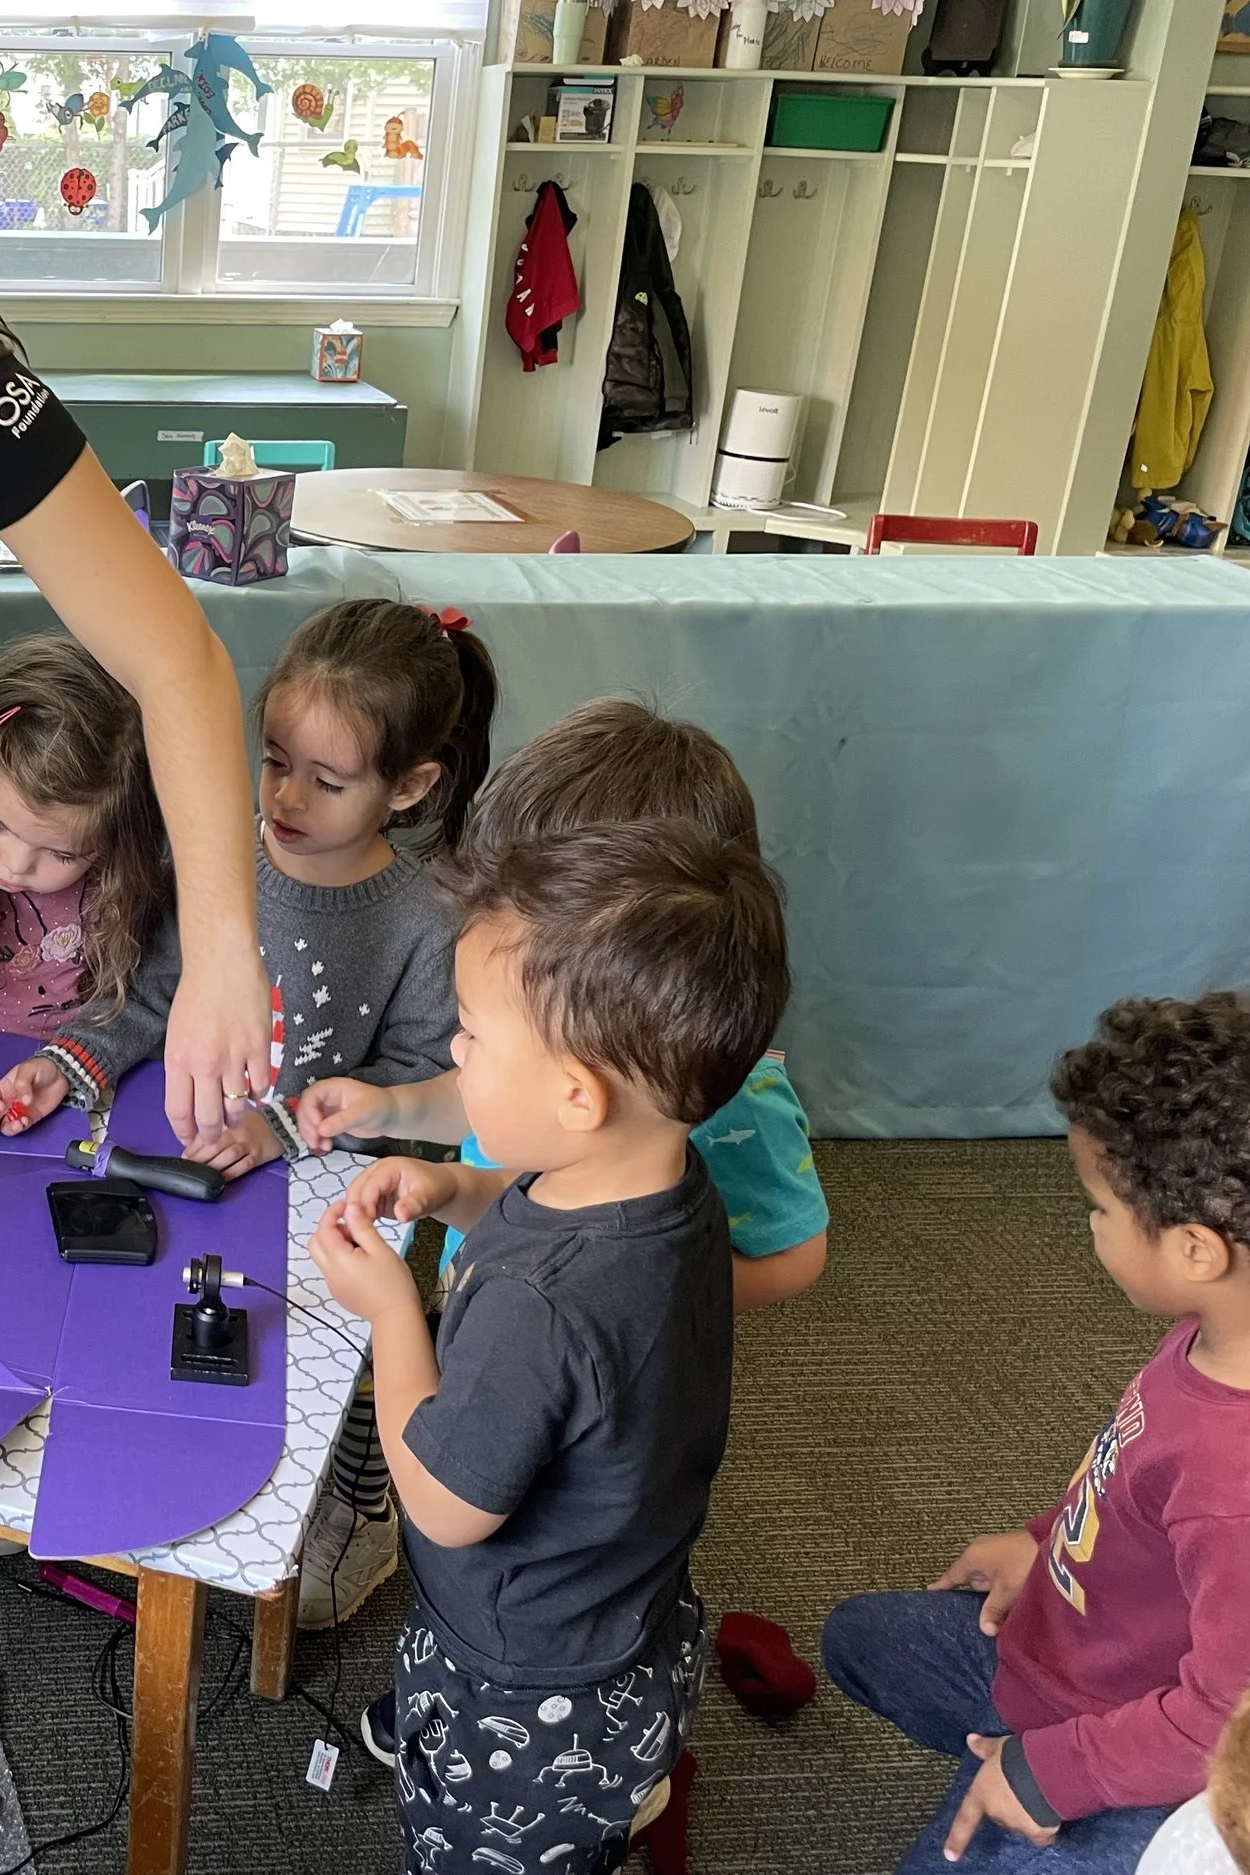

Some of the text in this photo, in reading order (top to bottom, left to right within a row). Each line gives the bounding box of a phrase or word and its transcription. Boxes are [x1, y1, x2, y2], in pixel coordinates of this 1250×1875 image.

[645, 55, 682, 67] ARDEN
[11, 388, 51, 439] Foundation
[186, 520, 216, 535] Kleenex
